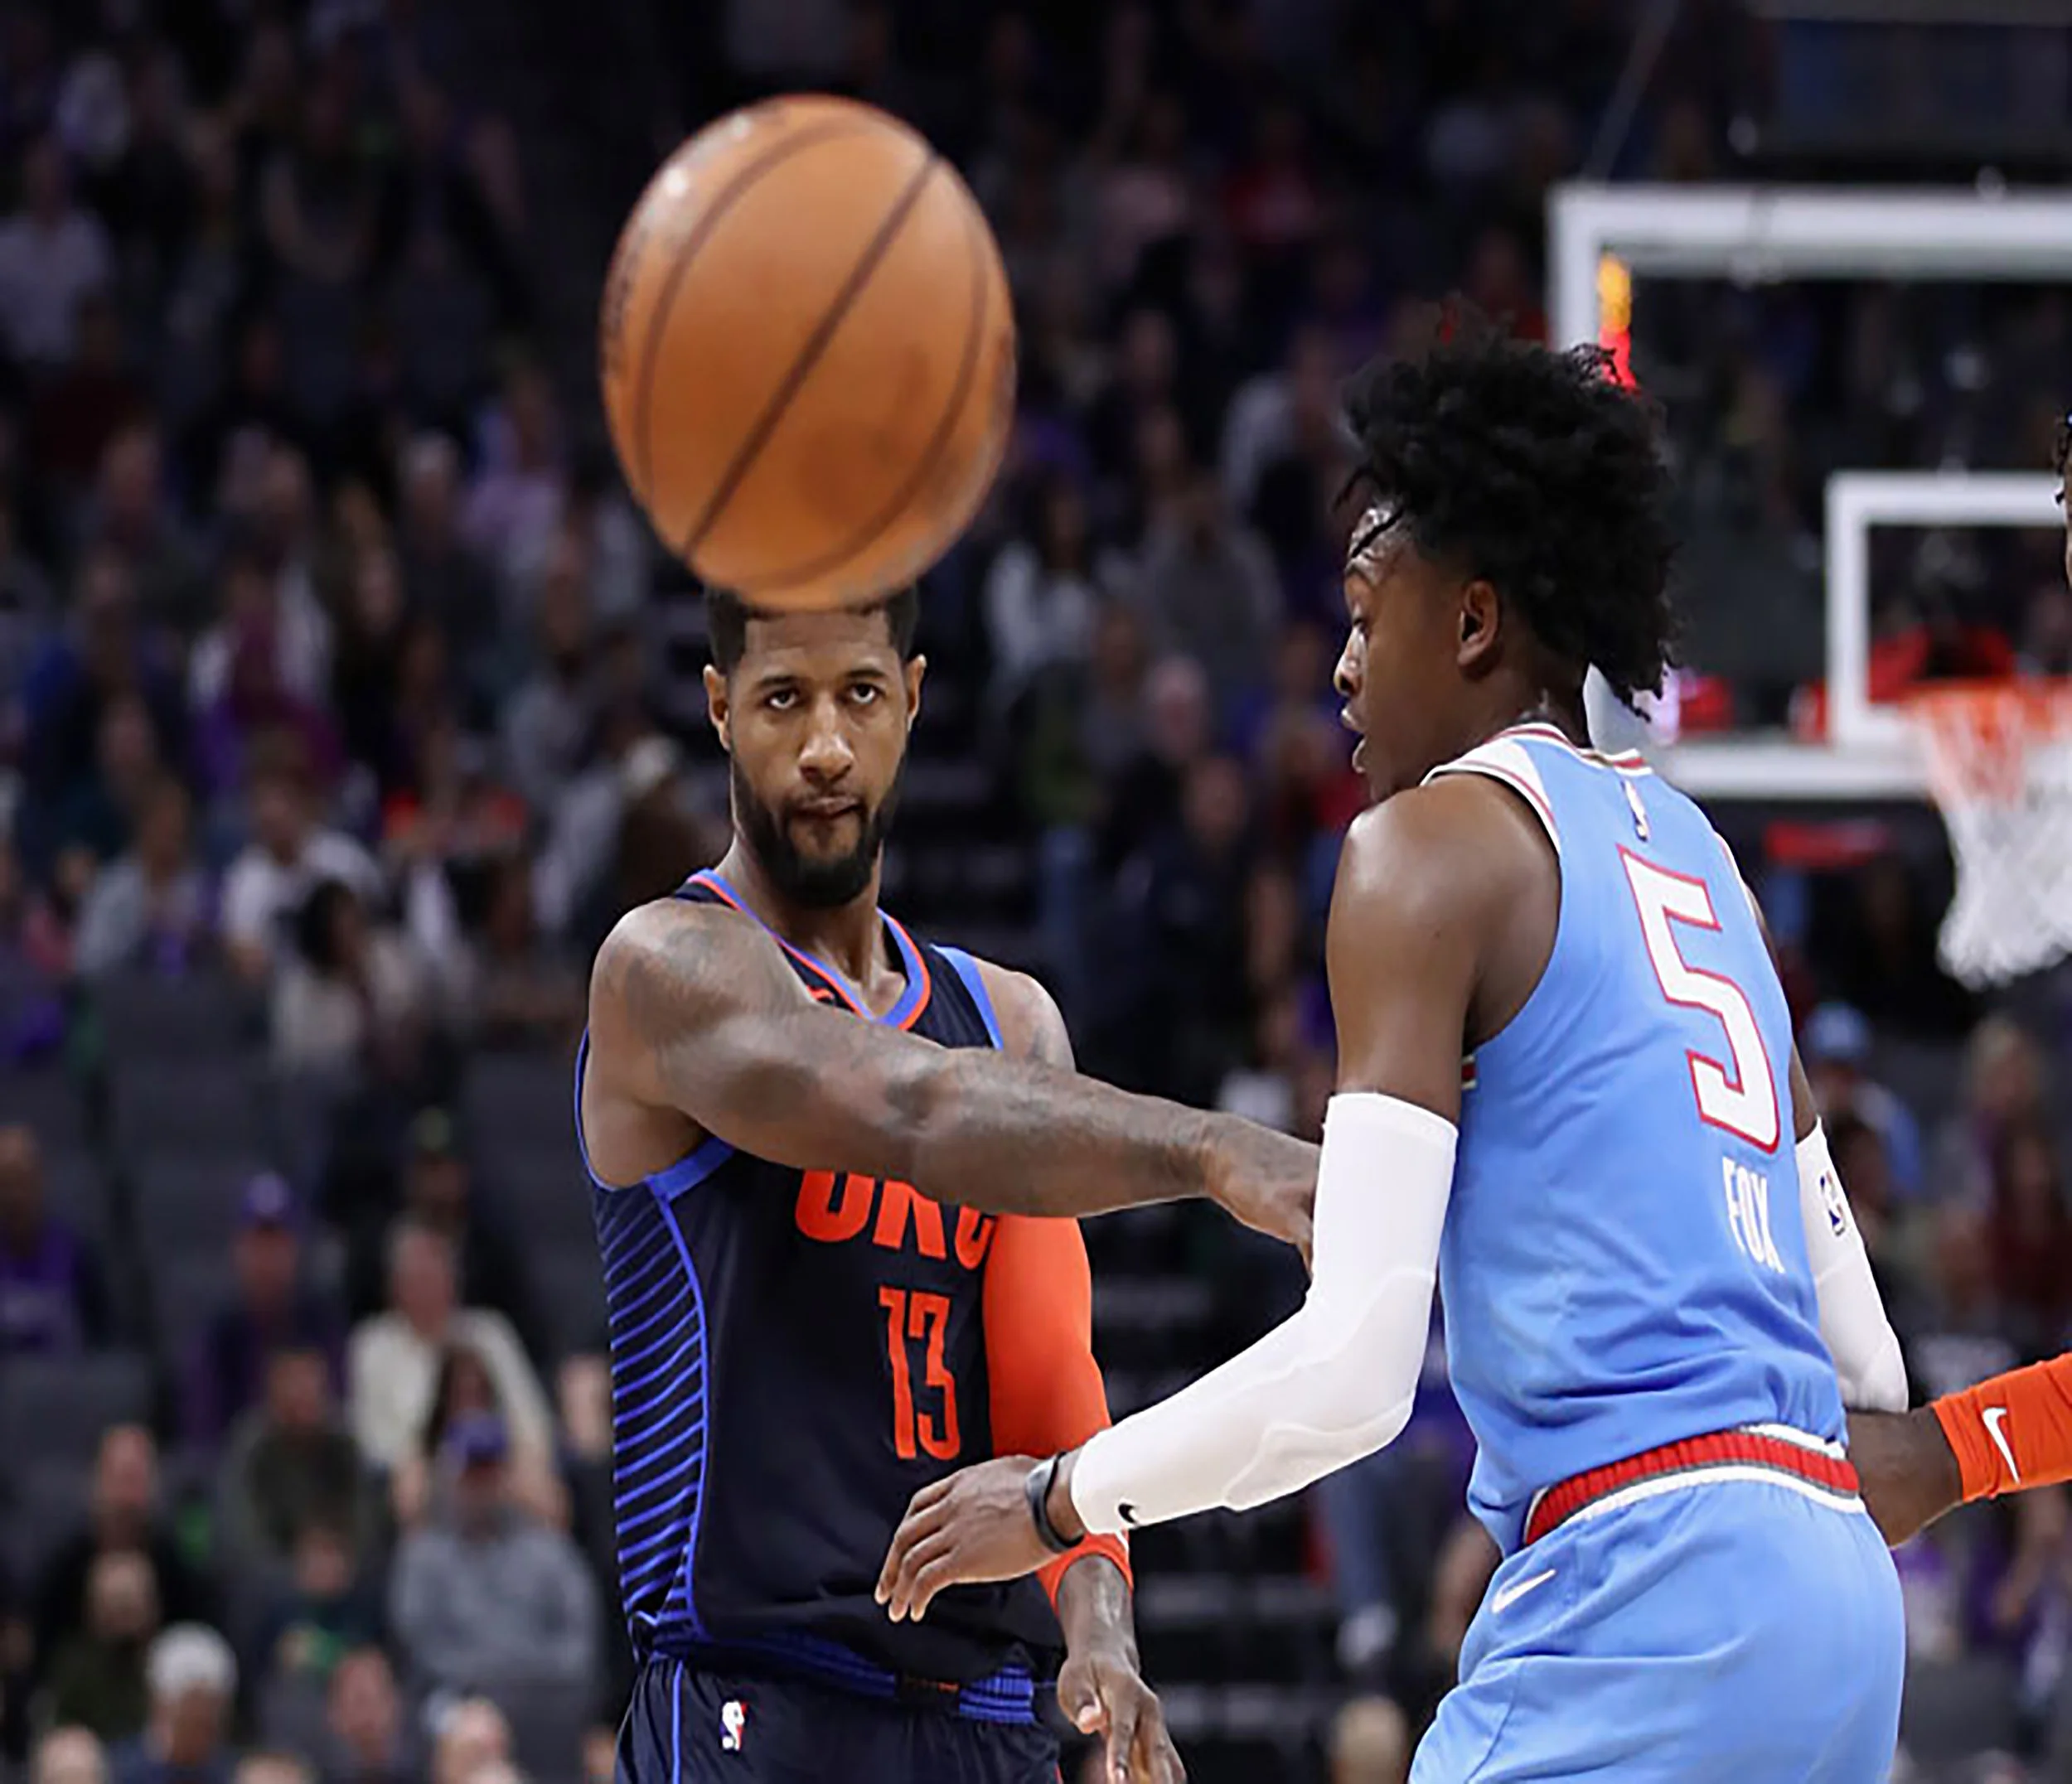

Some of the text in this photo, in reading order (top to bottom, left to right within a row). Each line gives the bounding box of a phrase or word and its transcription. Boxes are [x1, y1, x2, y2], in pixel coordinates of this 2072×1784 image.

[1615, 842, 1780, 1154] 5
[1721, 1156, 1786, 1274] FOX
[879, 1286, 961, 1460] 13
